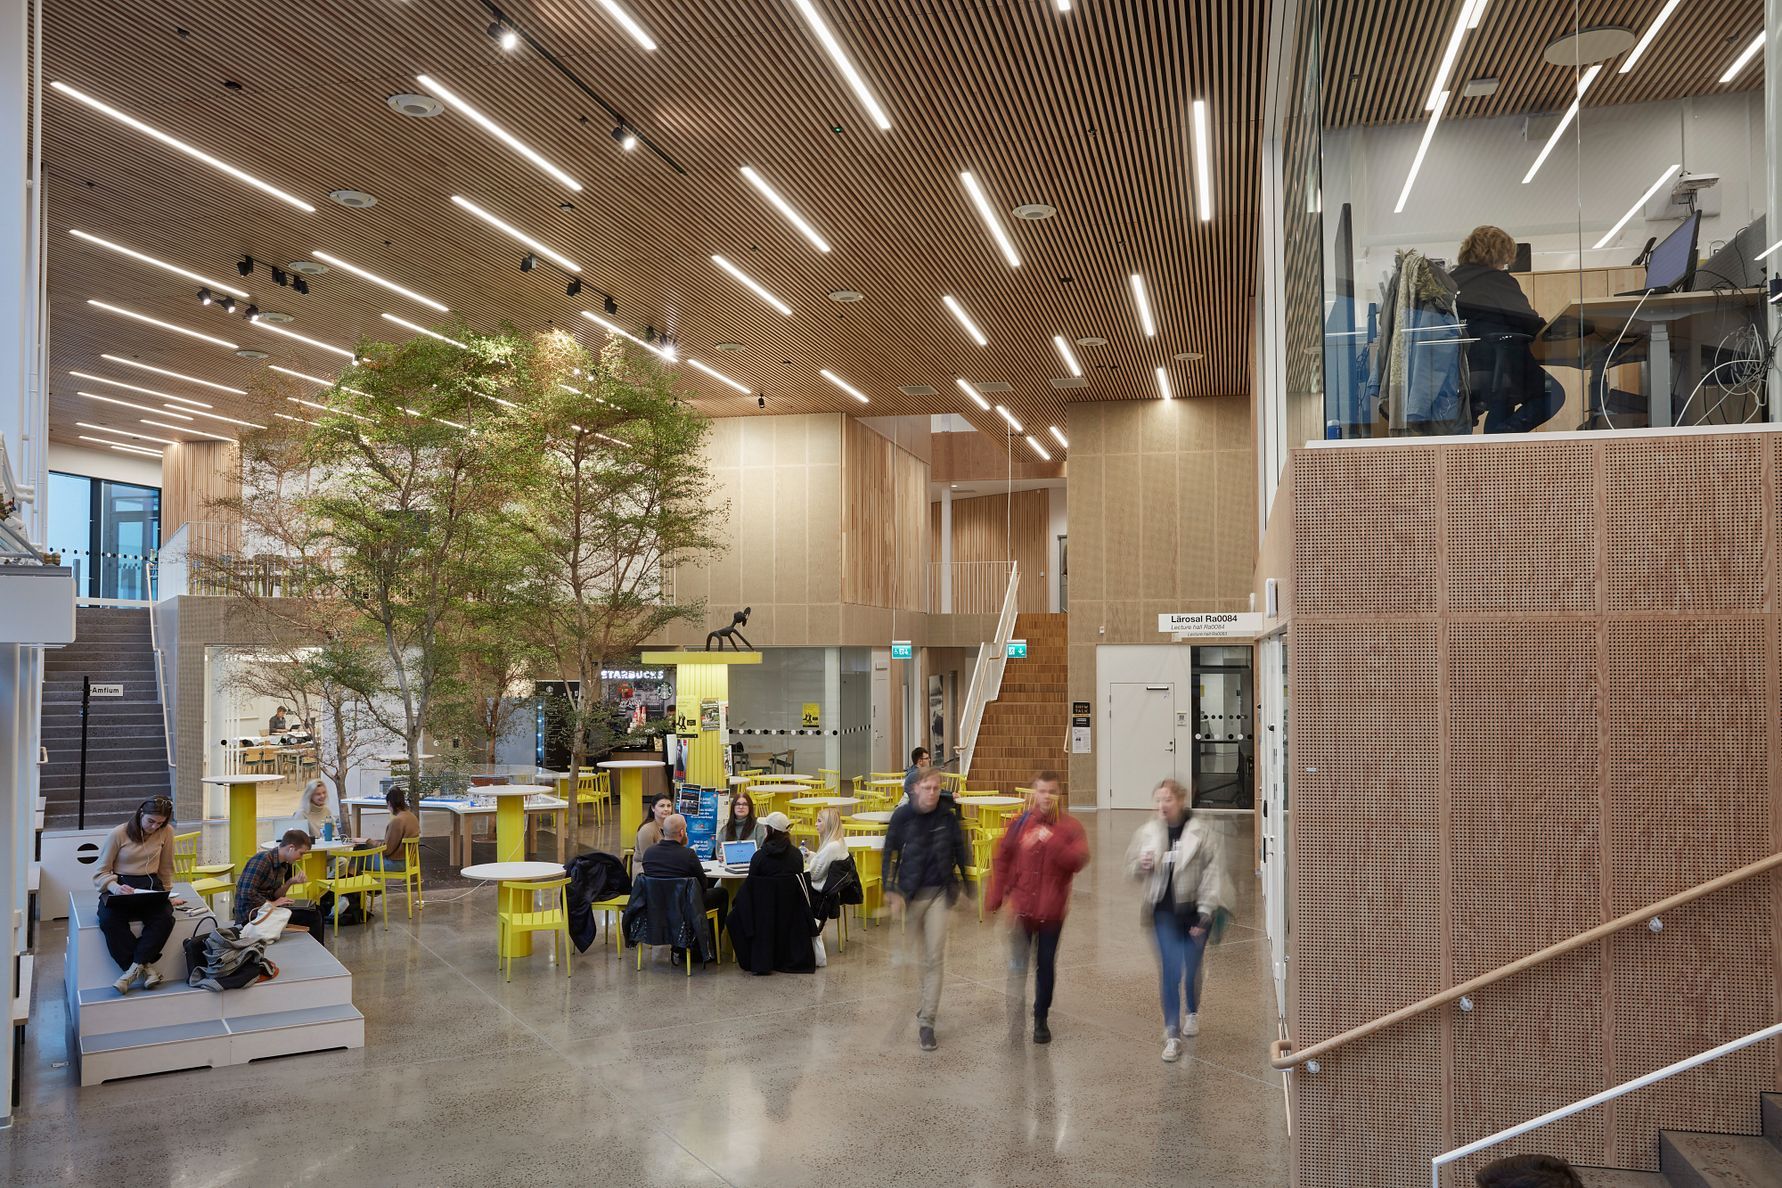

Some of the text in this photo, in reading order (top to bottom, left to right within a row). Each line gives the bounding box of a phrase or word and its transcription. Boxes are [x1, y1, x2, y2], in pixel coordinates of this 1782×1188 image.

[1171, 614, 1238, 623] Lärosal Ra0084
[600, 670, 664, 680] STARBUCKS
